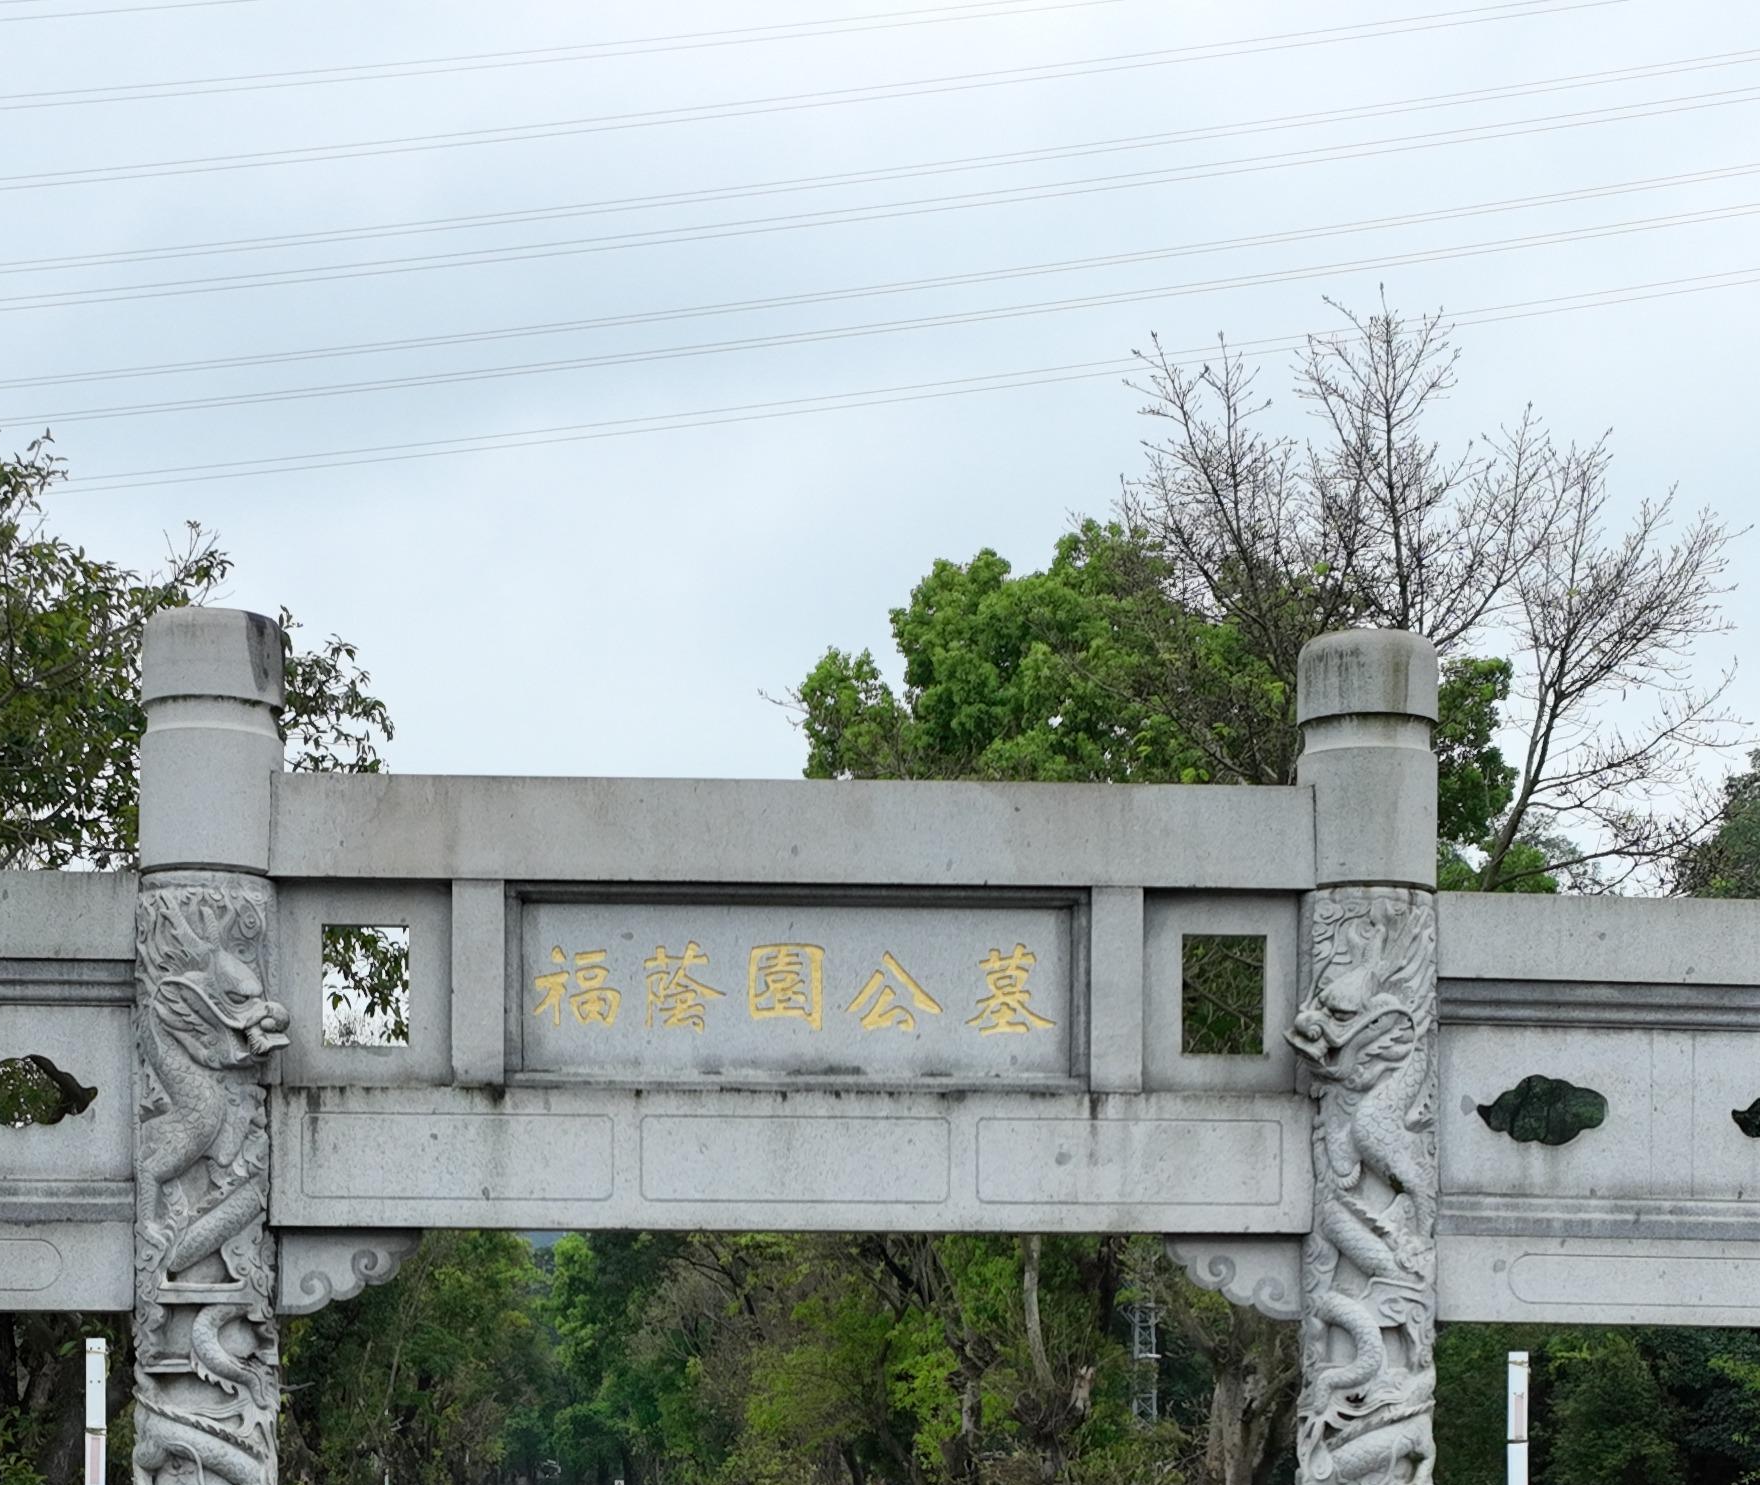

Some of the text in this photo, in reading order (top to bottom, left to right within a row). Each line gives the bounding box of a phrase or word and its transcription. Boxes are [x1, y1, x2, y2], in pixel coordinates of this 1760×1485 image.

[533, 940, 1057, 1037] 福蔭園公墓
